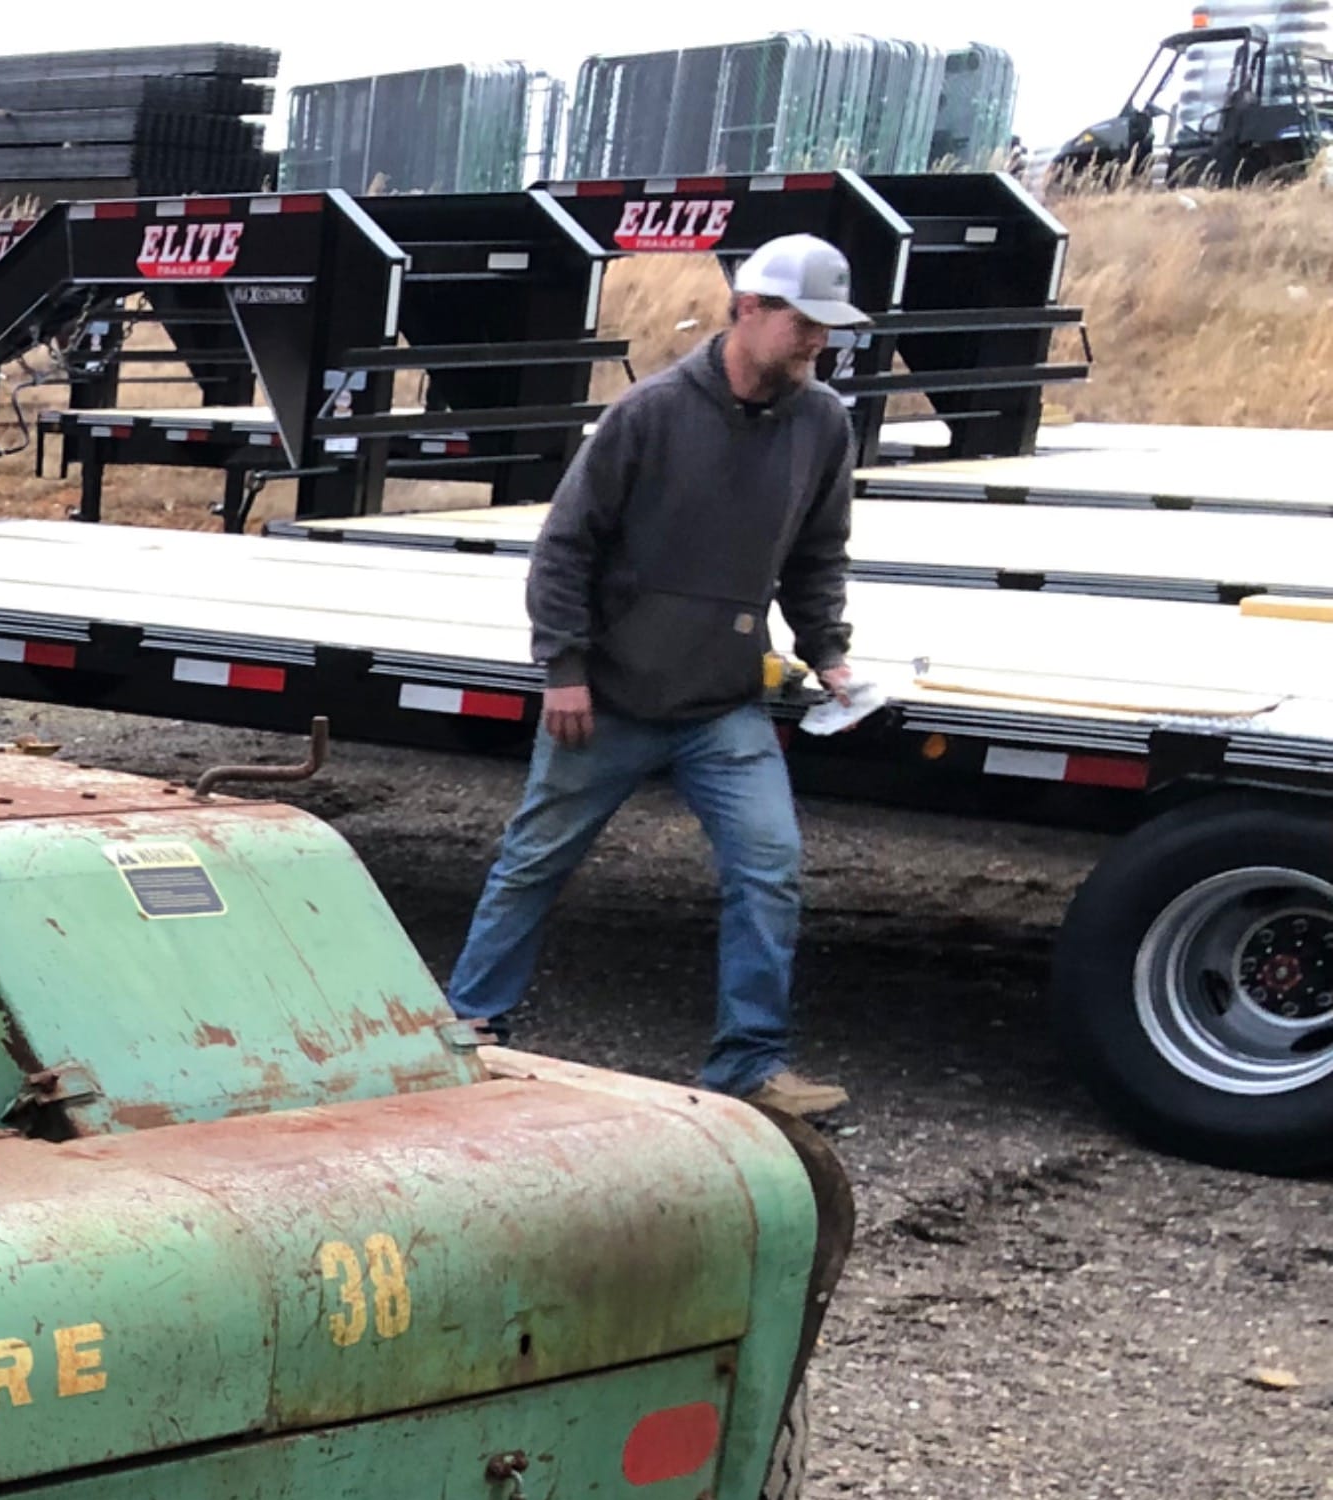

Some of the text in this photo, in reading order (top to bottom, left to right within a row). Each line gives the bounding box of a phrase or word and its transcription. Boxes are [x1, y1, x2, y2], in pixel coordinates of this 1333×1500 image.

[613, 200, 735, 237] ELITE
[135, 221, 245, 263] ELITE
[156, 265, 212, 275] TRAILERS
[319, 1232, 412, 1347] 38
